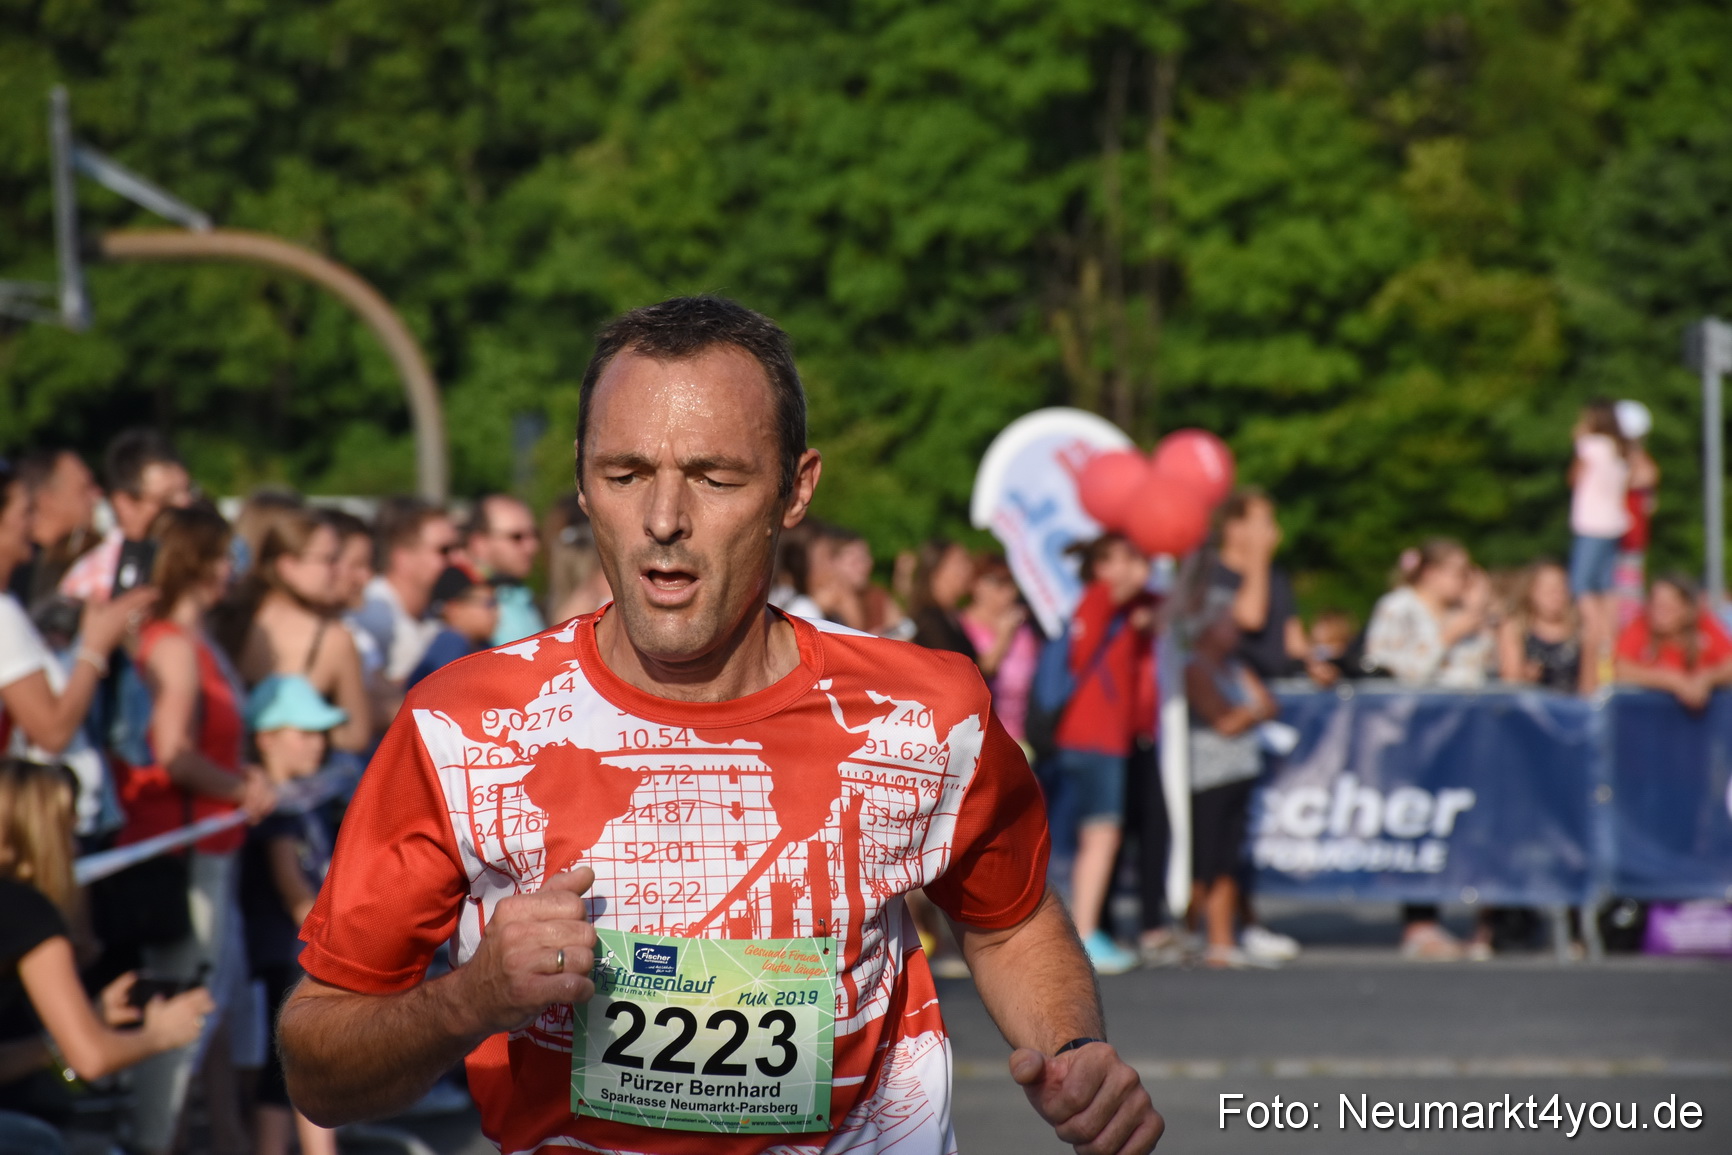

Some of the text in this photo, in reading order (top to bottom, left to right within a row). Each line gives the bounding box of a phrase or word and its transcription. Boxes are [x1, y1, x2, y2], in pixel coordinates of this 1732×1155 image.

[617, 727, 691, 750] 10.54
[864, 738, 946, 766] 91.62%
[621, 802, 697, 824] 24.87
[624, 841, 700, 864] 52.01
[624, 881, 702, 906] 26.22
[744, 944, 787, 959] Gesunde
[614, 967, 716, 994] firmenlauf
[614, 985, 656, 997] neumarkt
[774, 990, 818, 1006] 2019
[601, 1000, 798, 1078] 2223
[620, 1071, 781, 1098] Pürzer Bernhard
[600, 1088, 798, 1115] Sparkasse Neumarkt-Parsberg
